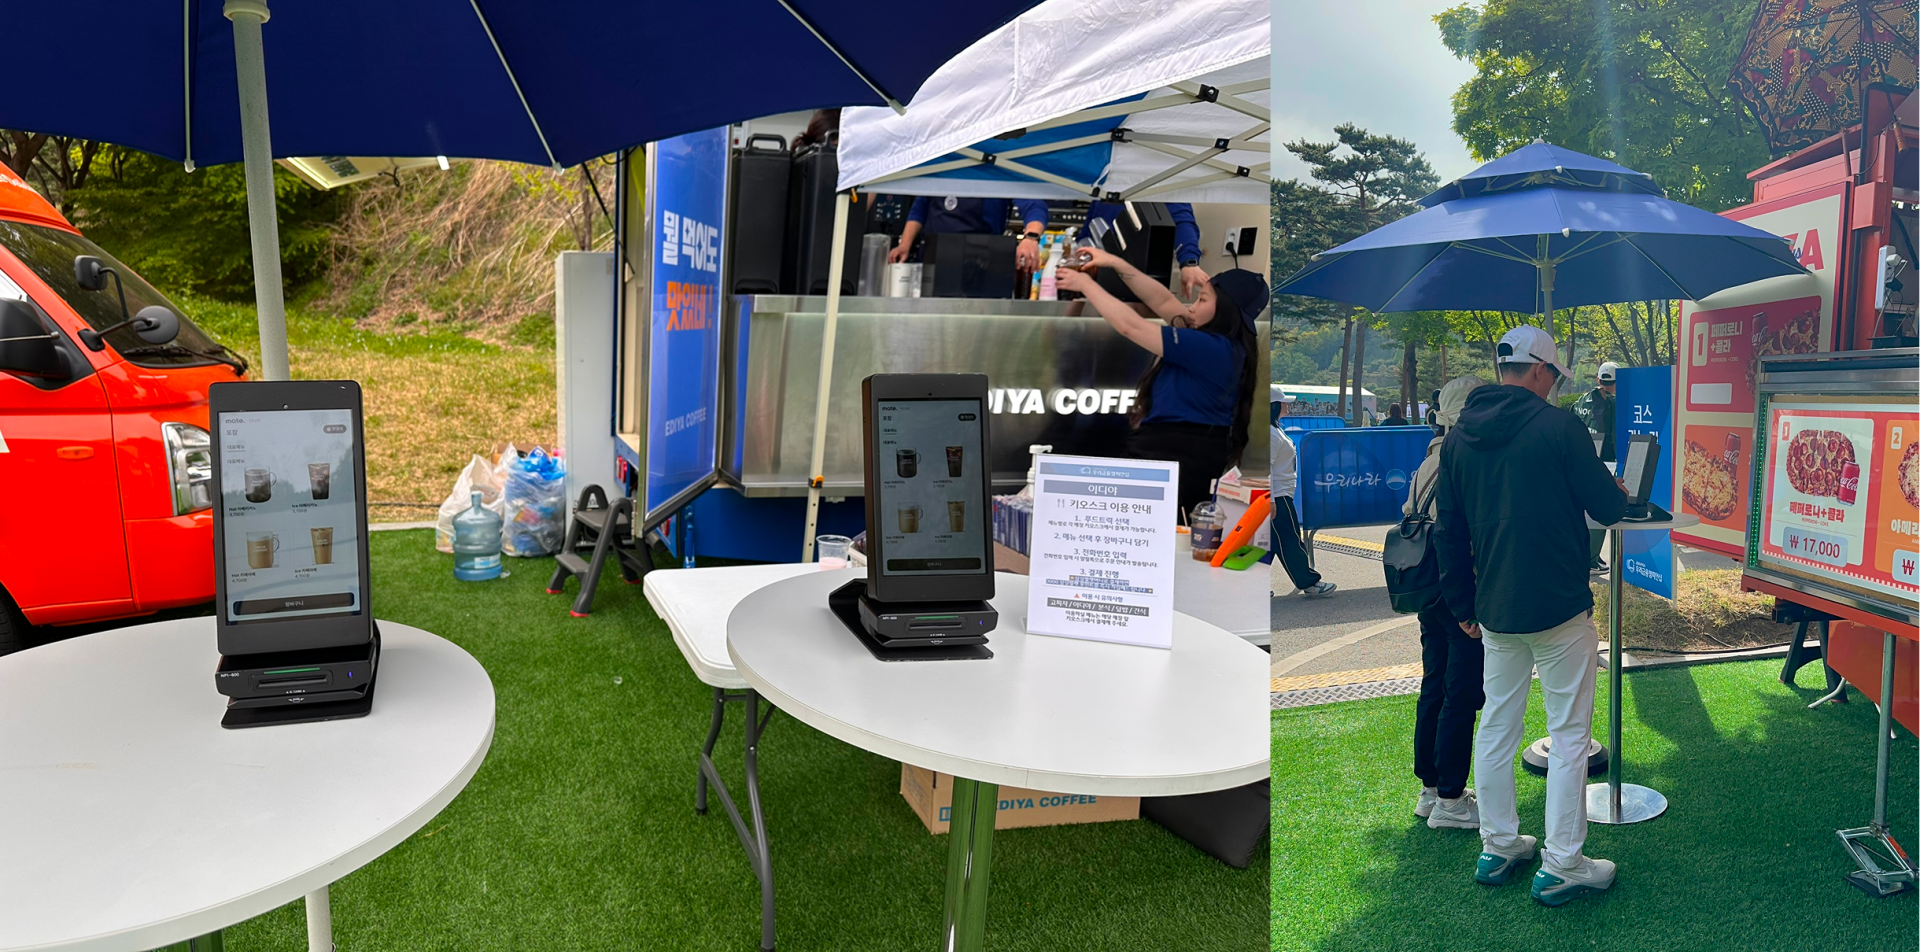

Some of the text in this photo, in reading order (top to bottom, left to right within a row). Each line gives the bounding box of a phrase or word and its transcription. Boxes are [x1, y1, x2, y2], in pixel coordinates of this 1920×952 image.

[662, 209, 718, 273] 뭘 먹어도
[1711, 321, 1743, 338] 페퍼로니
[1697, 332, 1704, 356] 1
[988, 388, 1045, 414] IYA
[665, 407, 707, 437] EDIYA COFFEE
[1633, 404, 1653, 424] 코스
[1893, 432, 1900, 444] 2
[1088, 484, 1118, 496] 이디야
[1314, 473, 1381, 493] 우리나라
[1070, 499, 1152, 514] 키오스크 이용 안내
[1789, 502, 1845, 523] 페퍼로니+콜라
[1085, 515, 1113, 524] 푸드트럭
[1115, 517, 1130, 526] 선택
[1062, 533, 1076, 541] 메뉴
[1078, 534, 1093, 543] 선택
[1103, 536, 1132, 546] 장바구니
[1134, 538, 1149, 547] 담기
[1803, 537, 1840, 559] 17,000
[1082, 548, 1111, 558] 전화번호
[1112, 550, 1127, 559] 입력
[1088, 568, 1103, 576] 결제
[1104, 570, 1119, 578] 진행
[1101, 594, 1124, 603] 유의사항
[997, 795, 1097, 810] DIYA COFFEE
